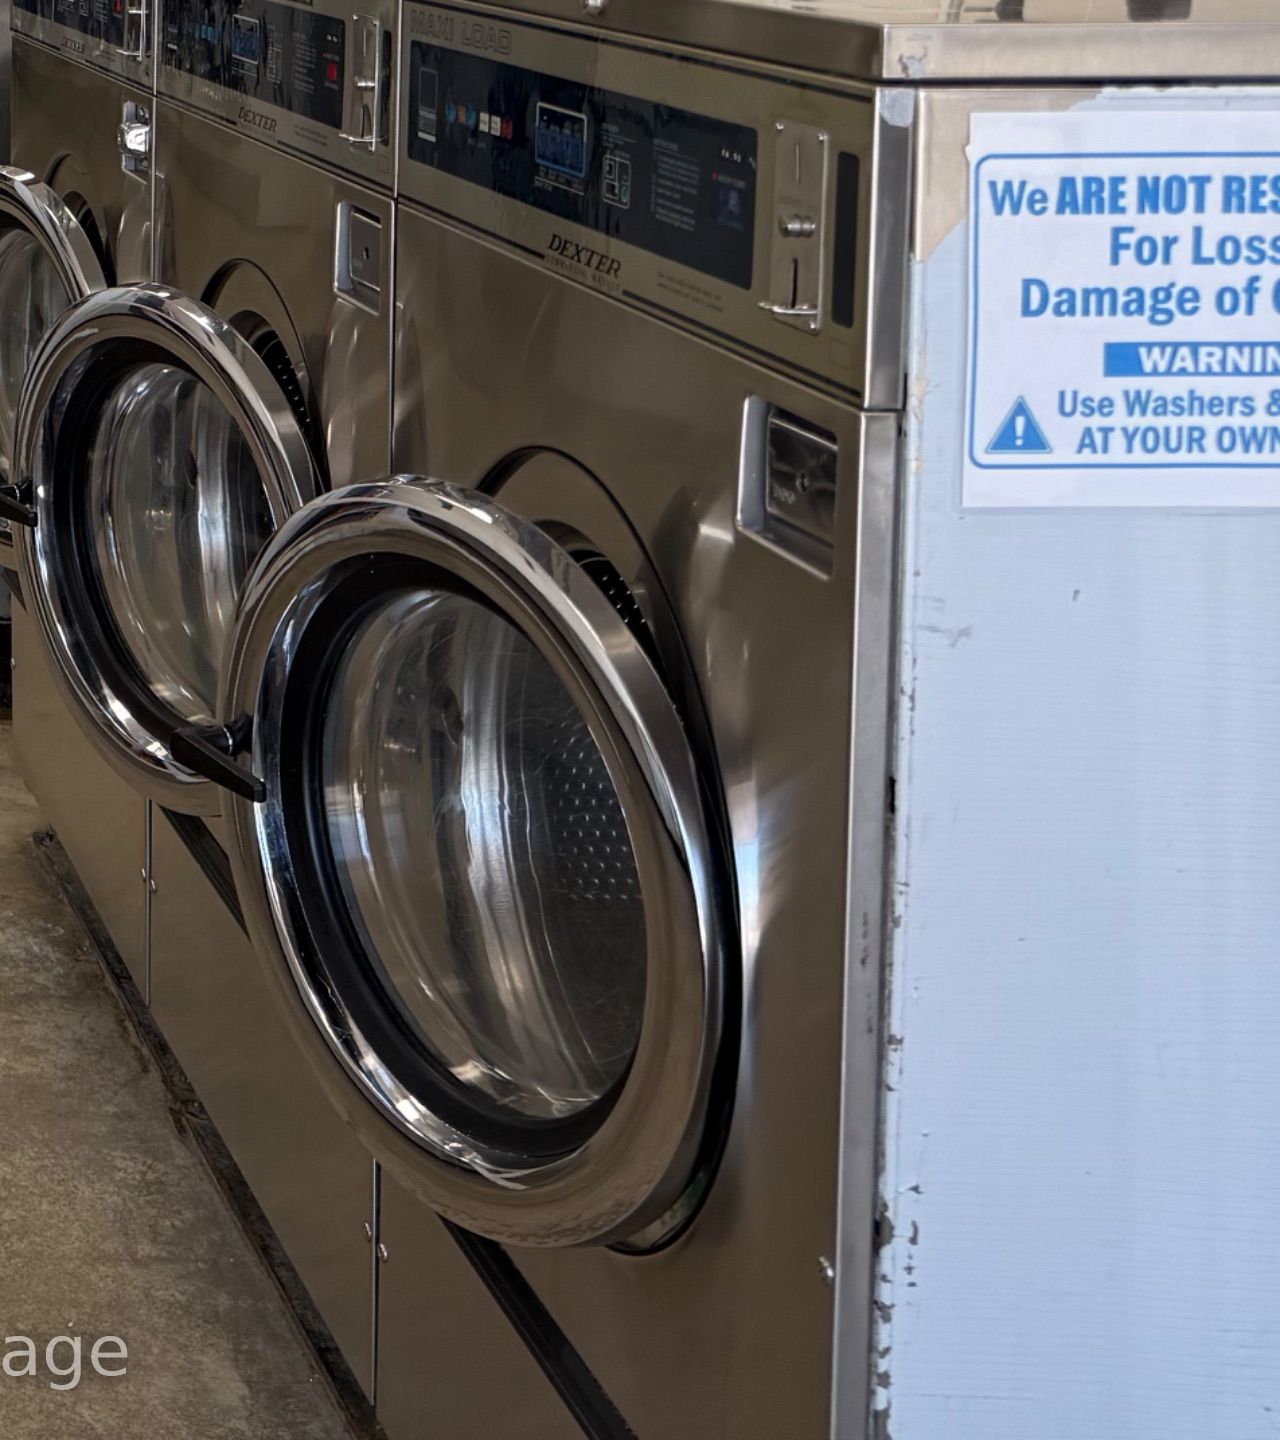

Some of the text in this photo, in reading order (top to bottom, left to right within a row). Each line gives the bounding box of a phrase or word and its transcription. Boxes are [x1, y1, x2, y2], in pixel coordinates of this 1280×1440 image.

[460, 20, 513, 56] LOAD
[238, 106, 278, 133] DEXTER
[988, 179, 1049, 217] We
[1055, 176, 1127, 215] ARE
[1139, 175, 1212, 215] NOT
[547, 233, 622, 279] DEXTER
[1109, 226, 1178, 266] For
[1020, 277, 1201, 326] Damage
[1215, 275, 1261, 317] of
[1057, 390, 1114, 418] Use
[1123, 389, 1255, 417] Washers
[1076, 426, 1115, 454] AT
[1119, 425, 1206, 454] YOUR
